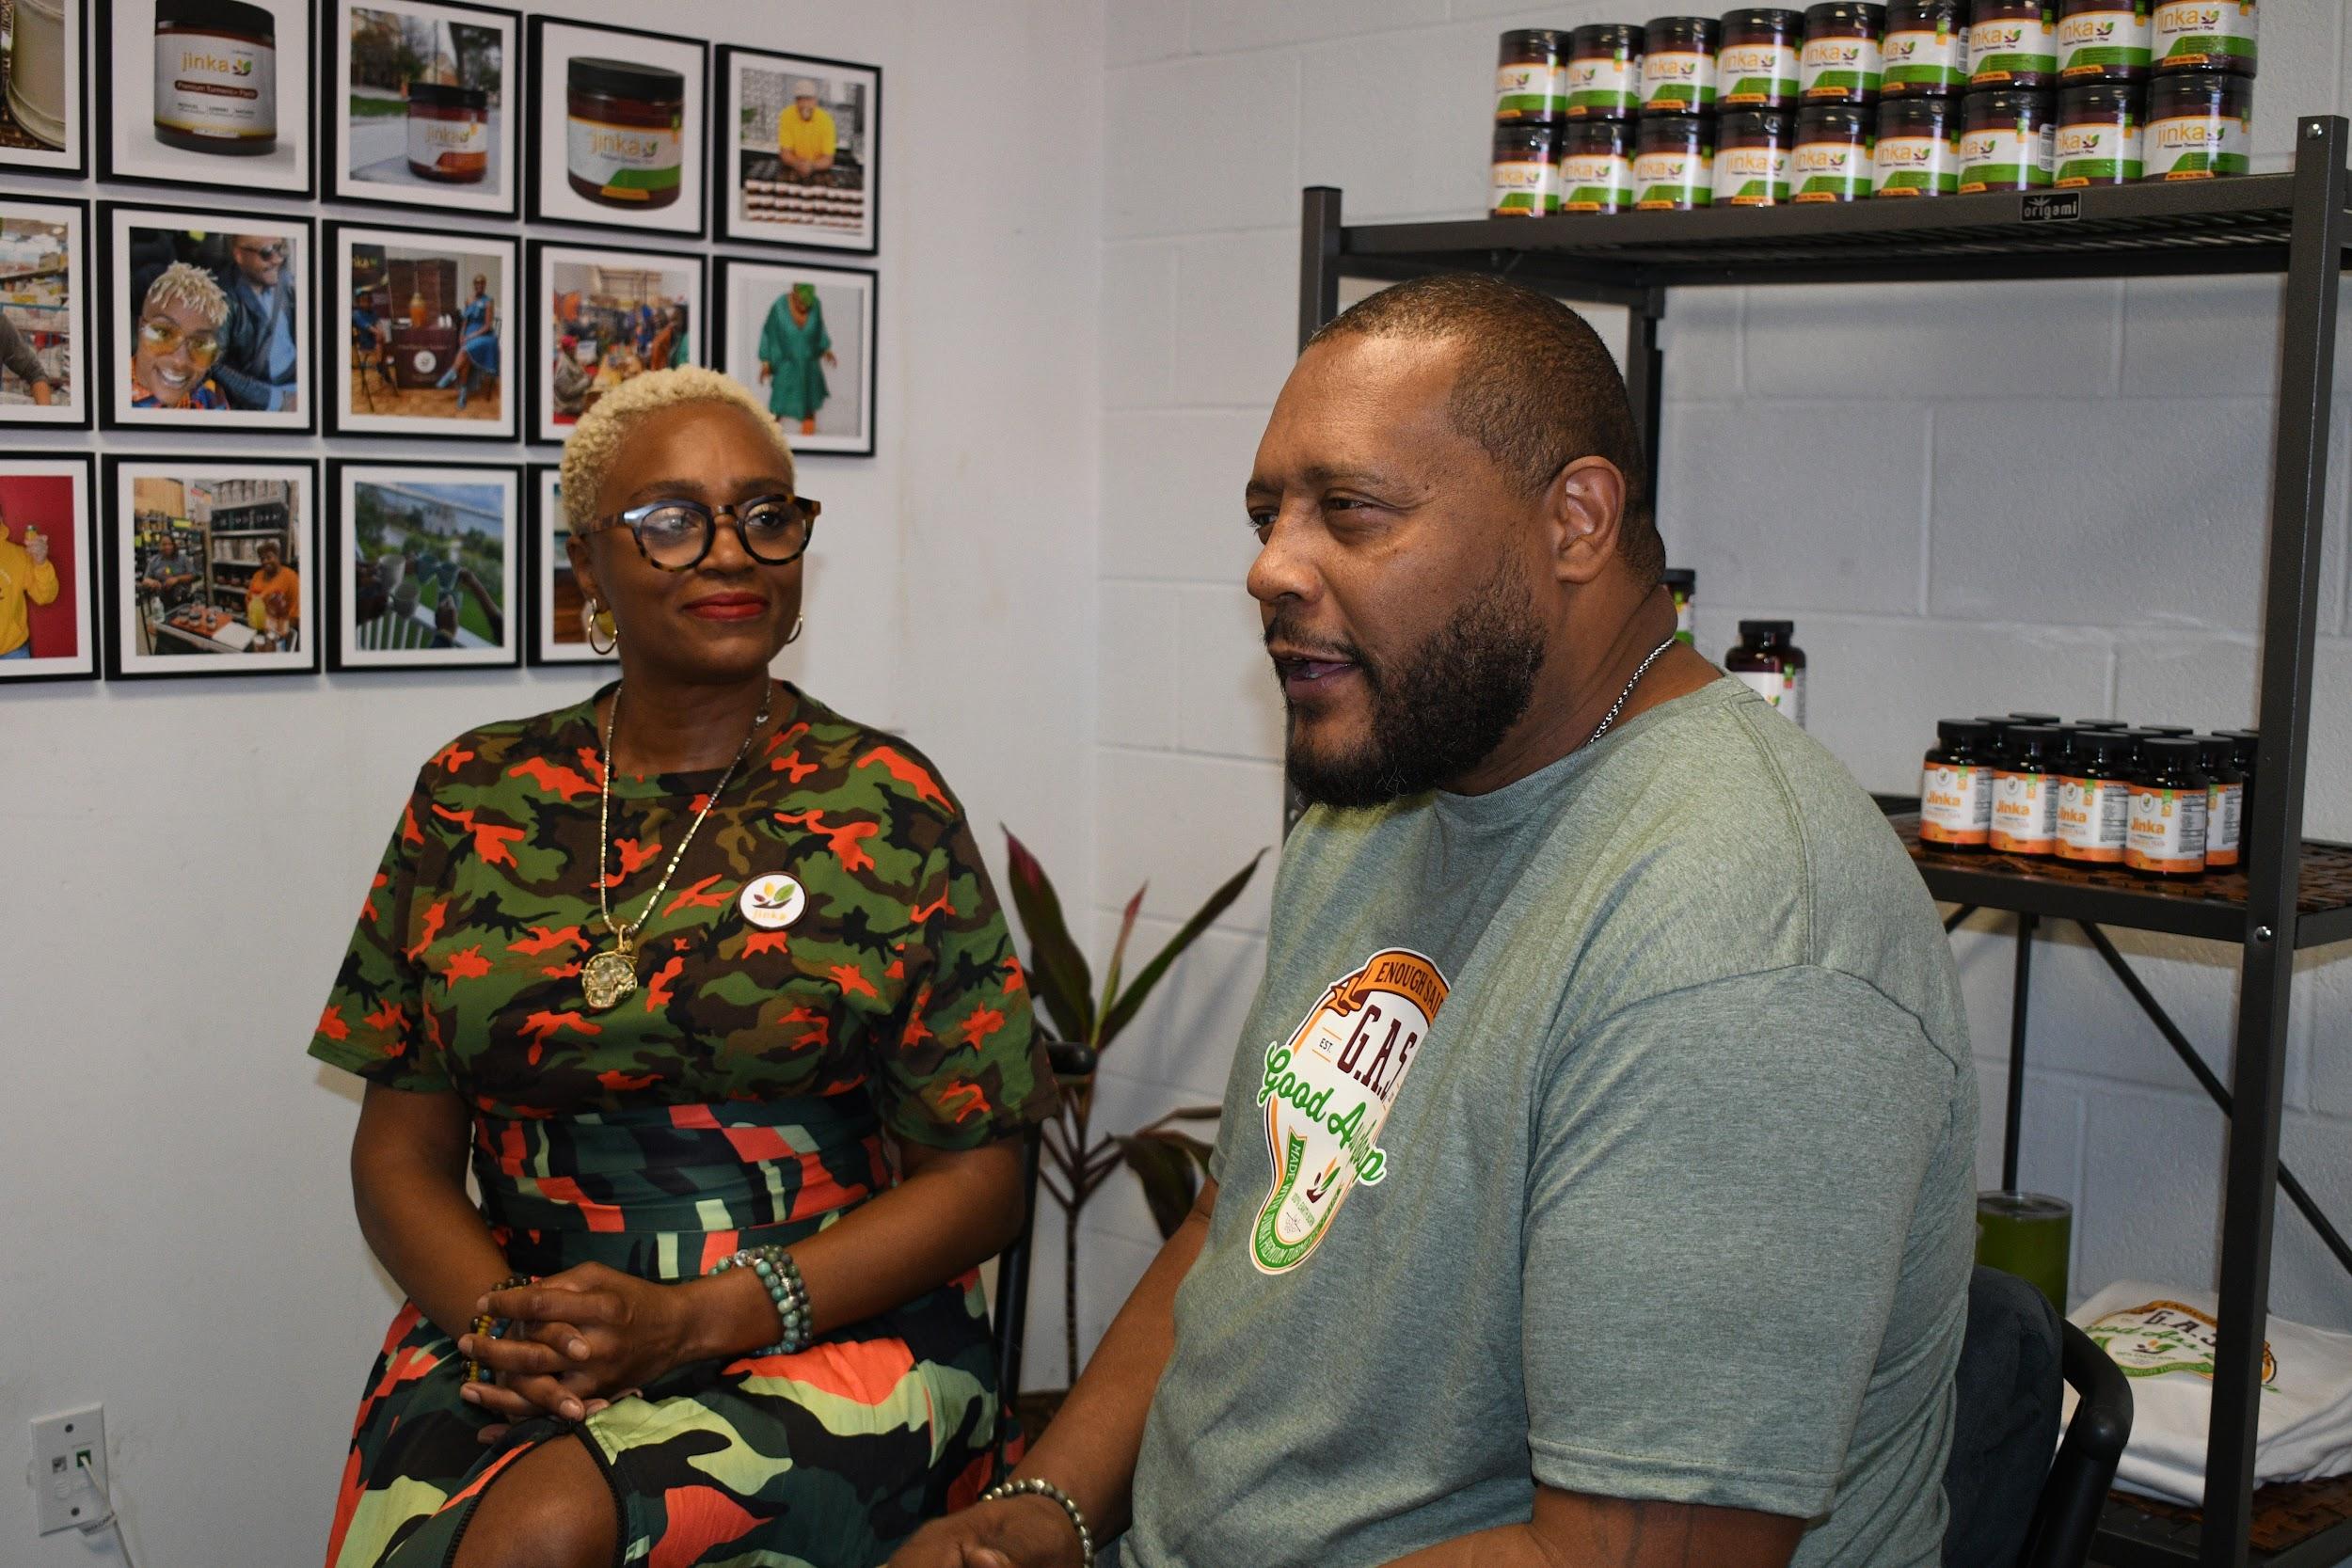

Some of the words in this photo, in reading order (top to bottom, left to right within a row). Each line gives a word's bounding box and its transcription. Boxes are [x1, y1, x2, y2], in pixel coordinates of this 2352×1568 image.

[2156, 8, 2199, 35] jinka
[2156, 123, 2205, 149] jinka
[2024, 200, 2077, 220] origami
[1375, 962, 1427, 992] ENOUGH
[1319, 1037, 1333, 1053] EST.
[1258, 1044, 1334, 1122] Good
[1286, 1143, 1301, 1180] MADE
